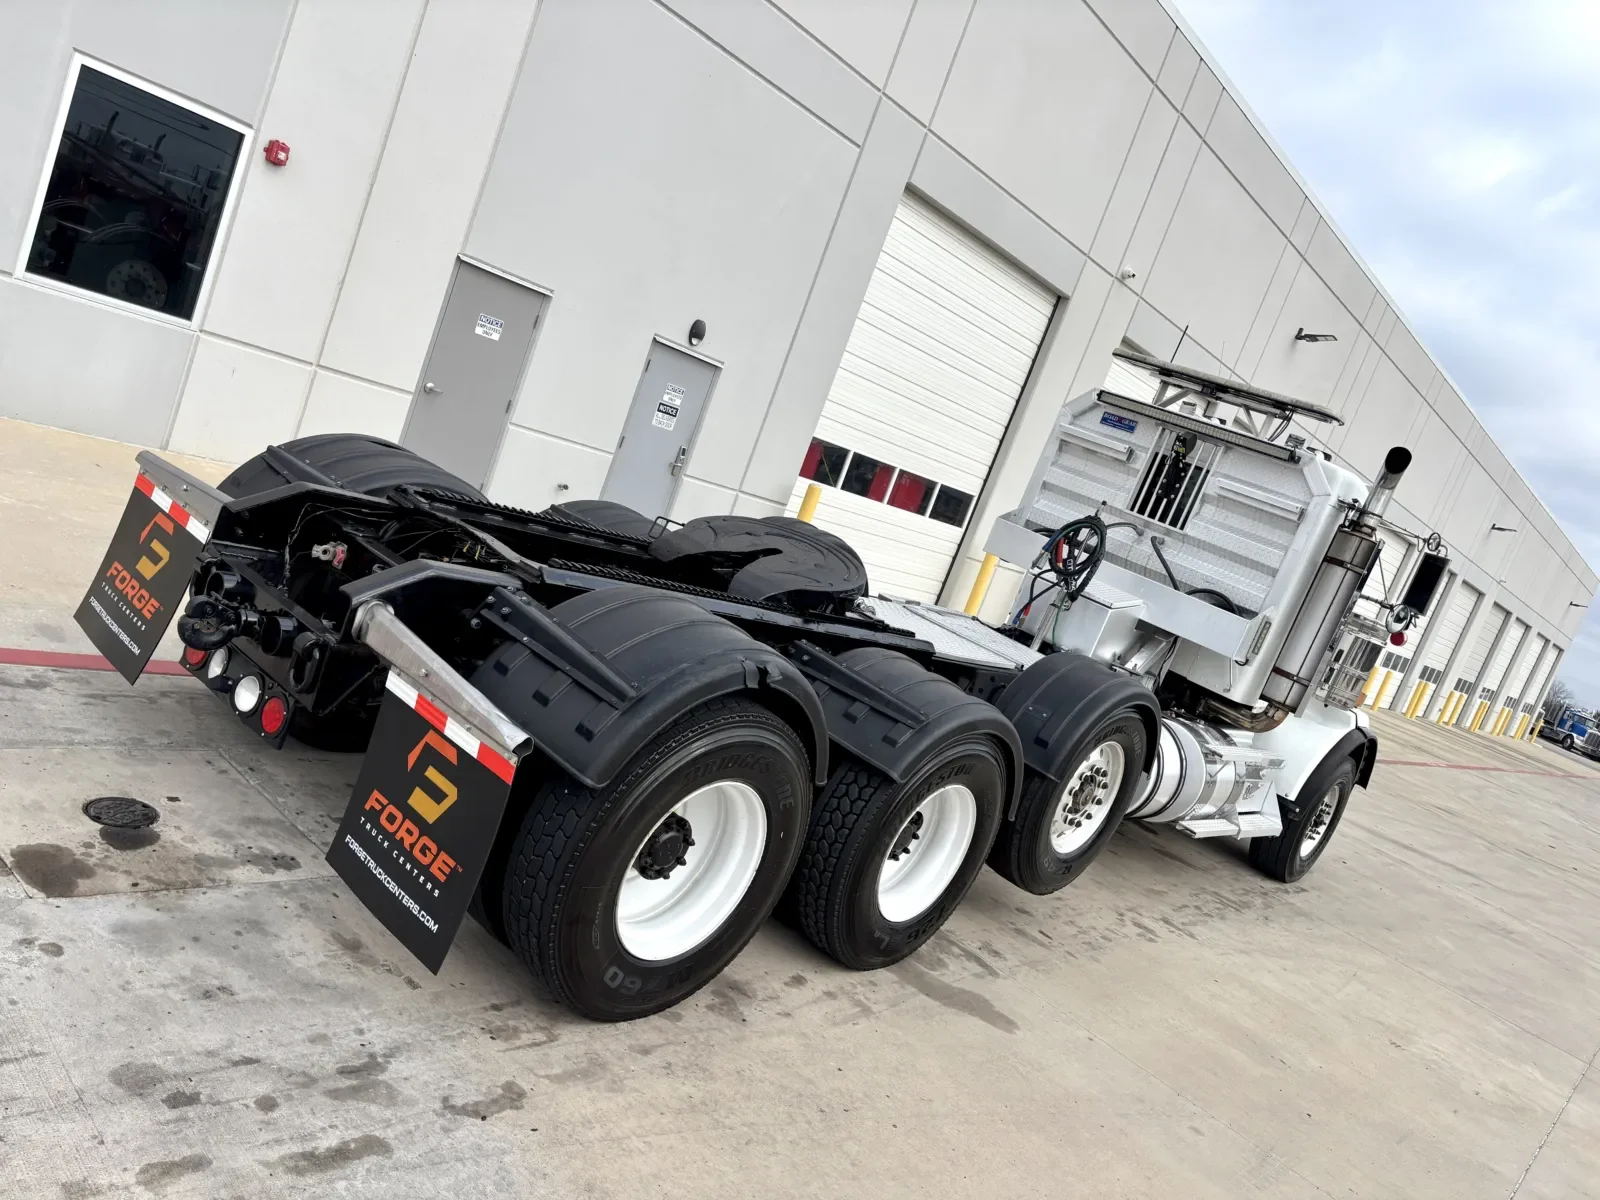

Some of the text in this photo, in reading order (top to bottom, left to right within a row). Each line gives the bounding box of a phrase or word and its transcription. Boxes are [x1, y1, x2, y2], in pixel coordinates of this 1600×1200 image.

[480, 314, 503, 328] NOTICE
[659, 404, 677, 416] NOTICE
[101, 581, 145, 631] TRUCK CENTERS
[106, 561, 161, 620] FORGE
[89, 595, 141, 656] FORGETRUCKCENTERS.COM
[681, 751, 795, 811] BRIDGESONE
[360, 816, 440, 897] TRUCK CENTERS
[364, 789, 457, 883] FORGE
[345, 834, 438, 933] FORGETRUCKCENTERS.COM
